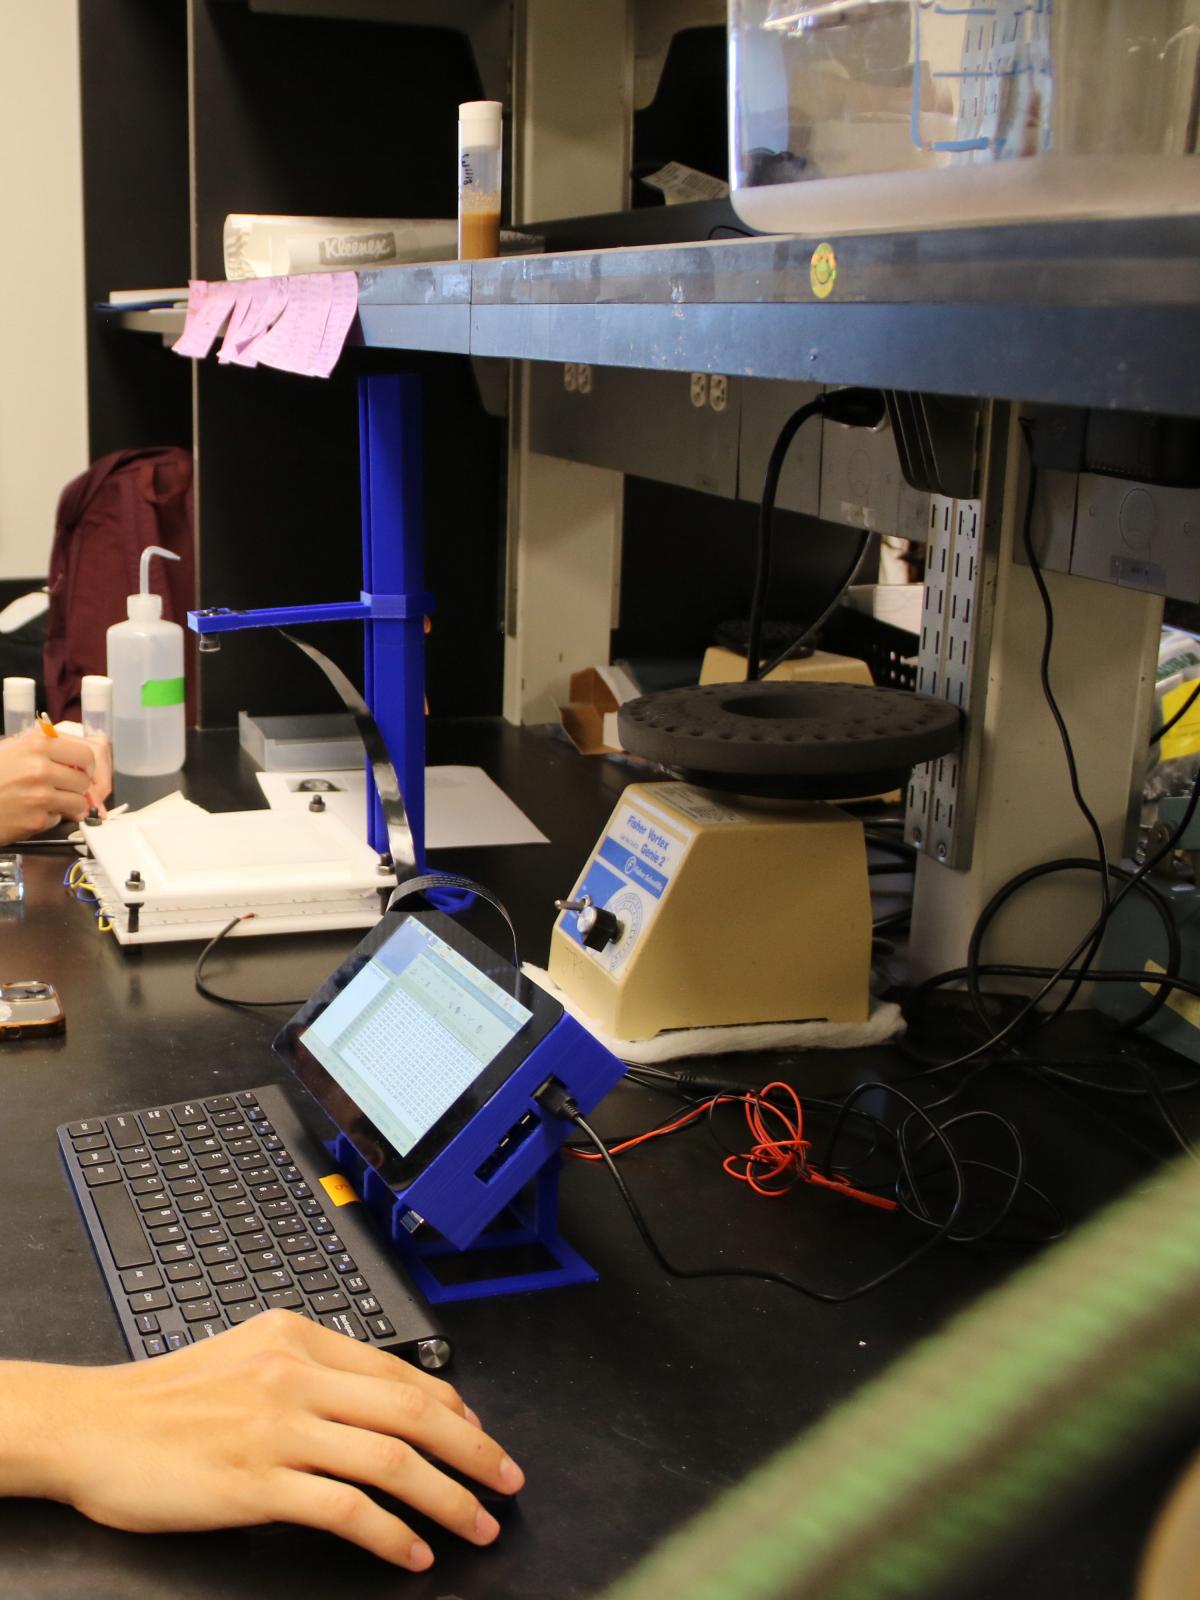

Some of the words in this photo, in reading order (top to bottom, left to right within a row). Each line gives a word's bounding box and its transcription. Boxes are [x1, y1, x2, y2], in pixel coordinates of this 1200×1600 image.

[324, 236, 391, 259] Kleenex
[627, 815, 647, 835] Fisher
[648, 827, 669, 851] Vortex
[641, 844, 660, 863] Genie
[658, 856, 666, 867] 2
